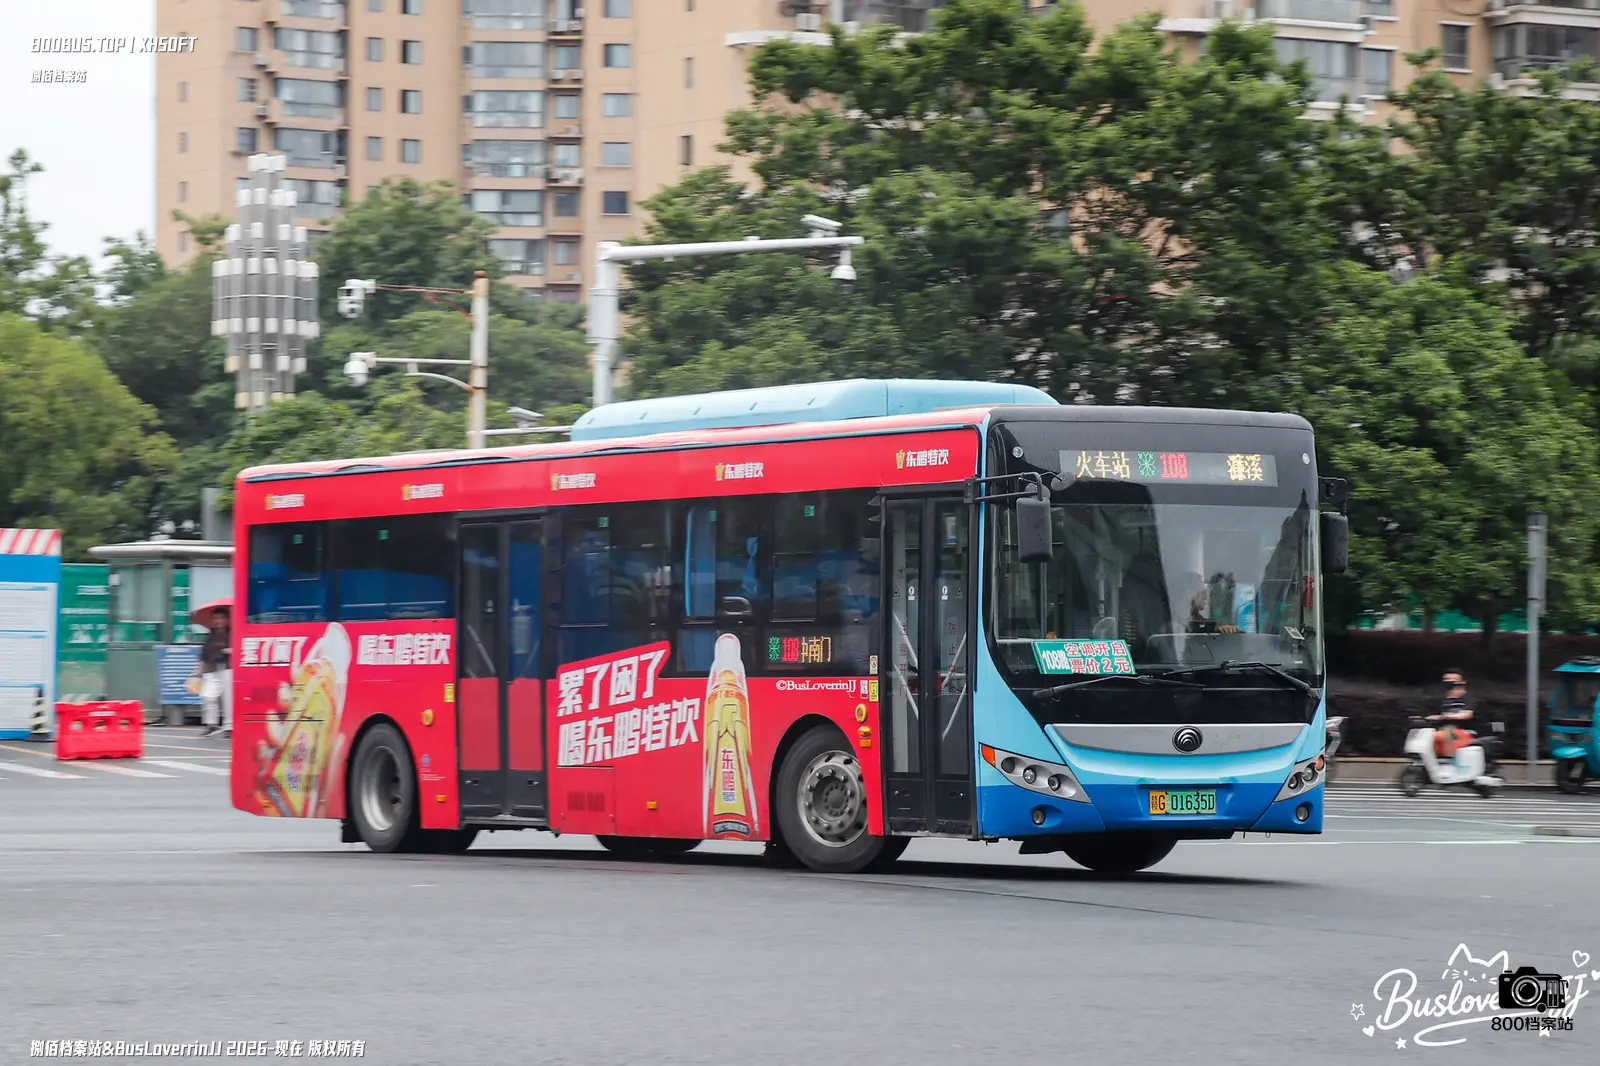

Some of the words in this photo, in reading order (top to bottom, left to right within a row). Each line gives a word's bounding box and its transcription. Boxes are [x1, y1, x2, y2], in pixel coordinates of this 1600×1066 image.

[906, 449, 949, 467] 东鹏特饮
[1076, 451, 1131, 478] 火车站
[1160, 453, 1188, 478] 108
[356, 633, 451, 665] 喝东鹏特饮
[1064, 642, 1127, 656] 空调开启
[1070, 658, 1131, 673] 票价2元
[556, 649, 666, 717] 累了困了
[557, 696, 701, 766] 喝东鹏特饮
